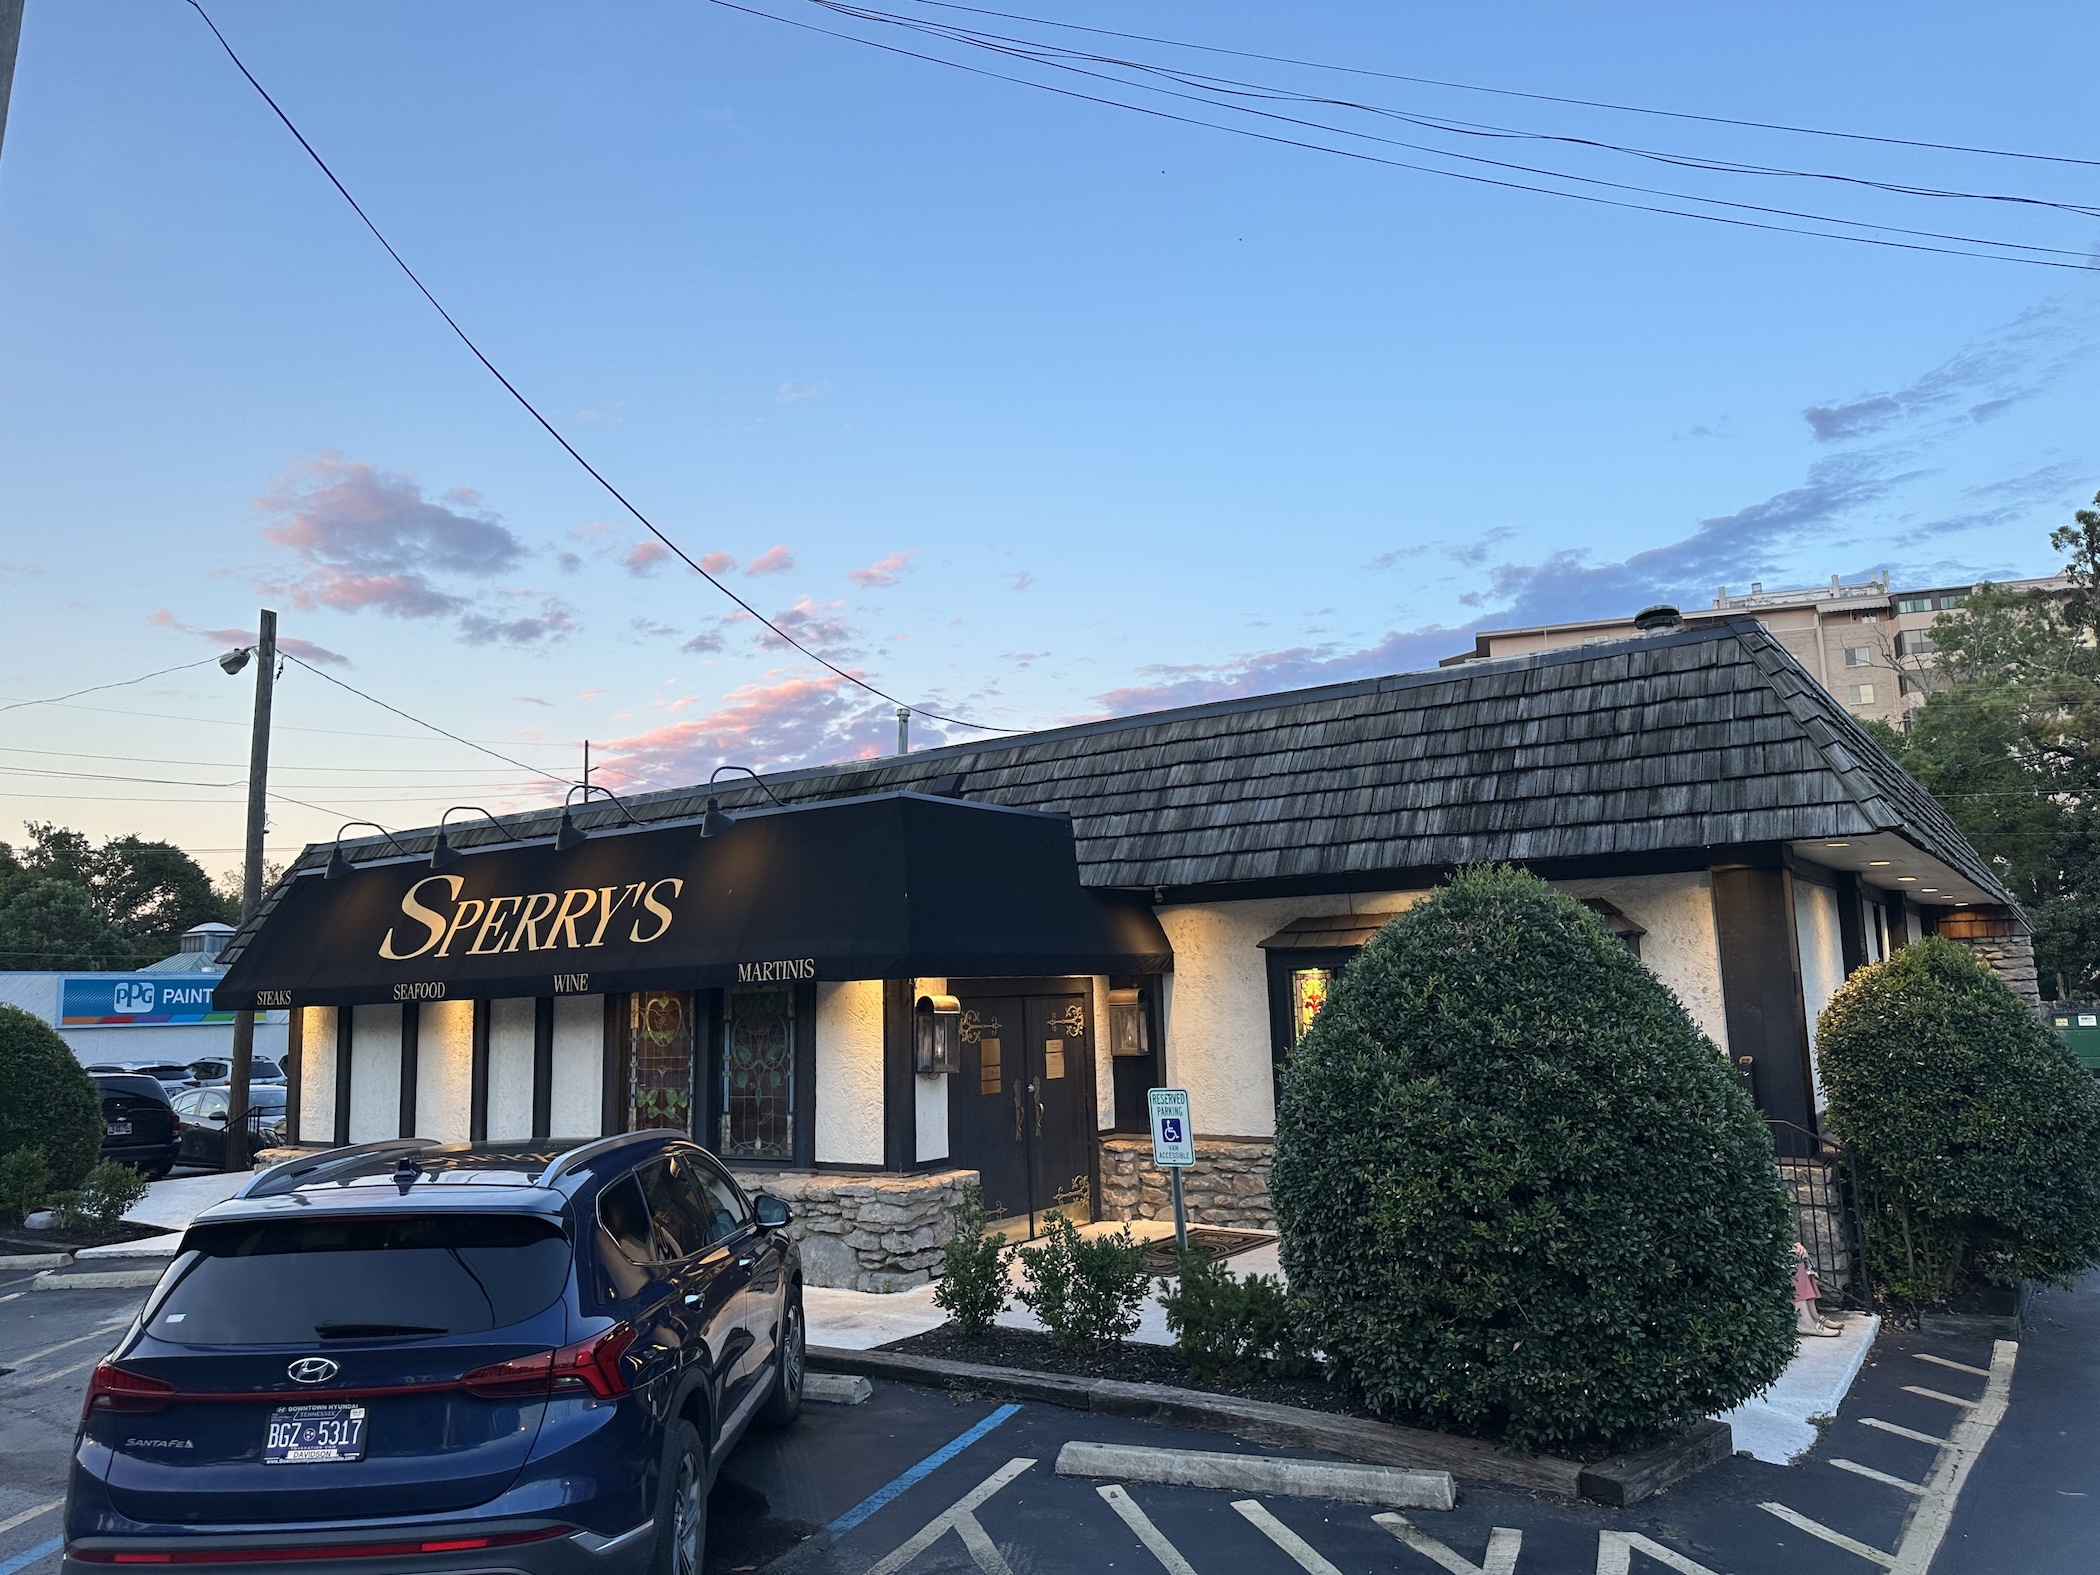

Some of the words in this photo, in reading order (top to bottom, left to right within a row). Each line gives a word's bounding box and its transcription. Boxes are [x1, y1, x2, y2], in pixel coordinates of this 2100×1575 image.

[378, 874, 683, 962] SPERRY'S
[737, 958, 816, 983] MARTINIS
[392, 981, 446, 1001] SEAFOOD
[553, 973, 589, 993] WINE
[256, 989, 292, 1006] STEAKS
[1152, 1093, 1185, 1105] RESERVED
[1157, 1106, 1183, 1117] PARKING
[1159, 1152, 1190, 1160] ACCESSIBLE
[300, 1410, 336, 1418] TENNESSEE
[267, 1422, 302, 1448] BGZ
[318, 1419, 362, 1446] 5317
[293, 1450, 332, 1458] DAVIDSON
